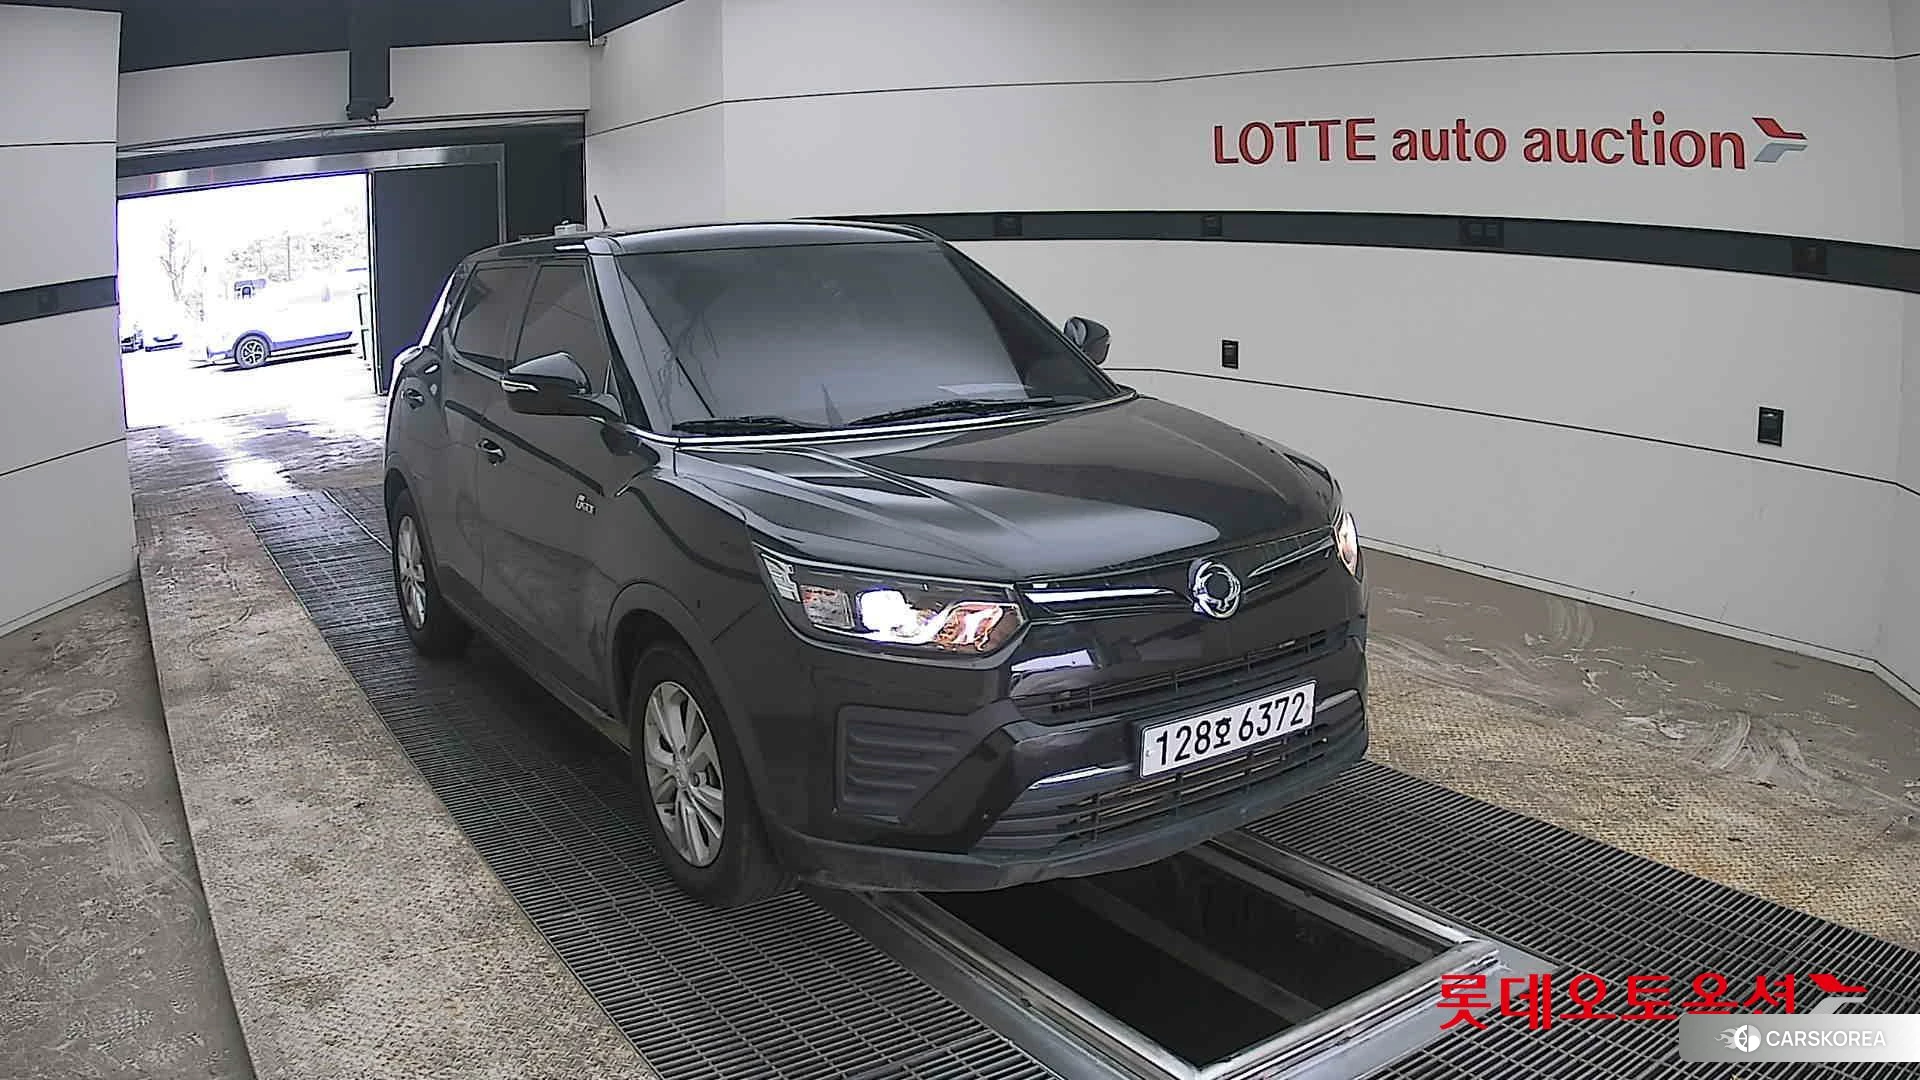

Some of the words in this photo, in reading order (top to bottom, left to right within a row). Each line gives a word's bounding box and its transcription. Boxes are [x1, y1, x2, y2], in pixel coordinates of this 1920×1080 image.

[1213, 117, 1376, 165] LOTTE
[1391, 118, 1507, 163] auto
[1522, 111, 1747, 171] auction
[1156, 716, 1233, 766] 128호
[1238, 691, 1306, 743] 6372
